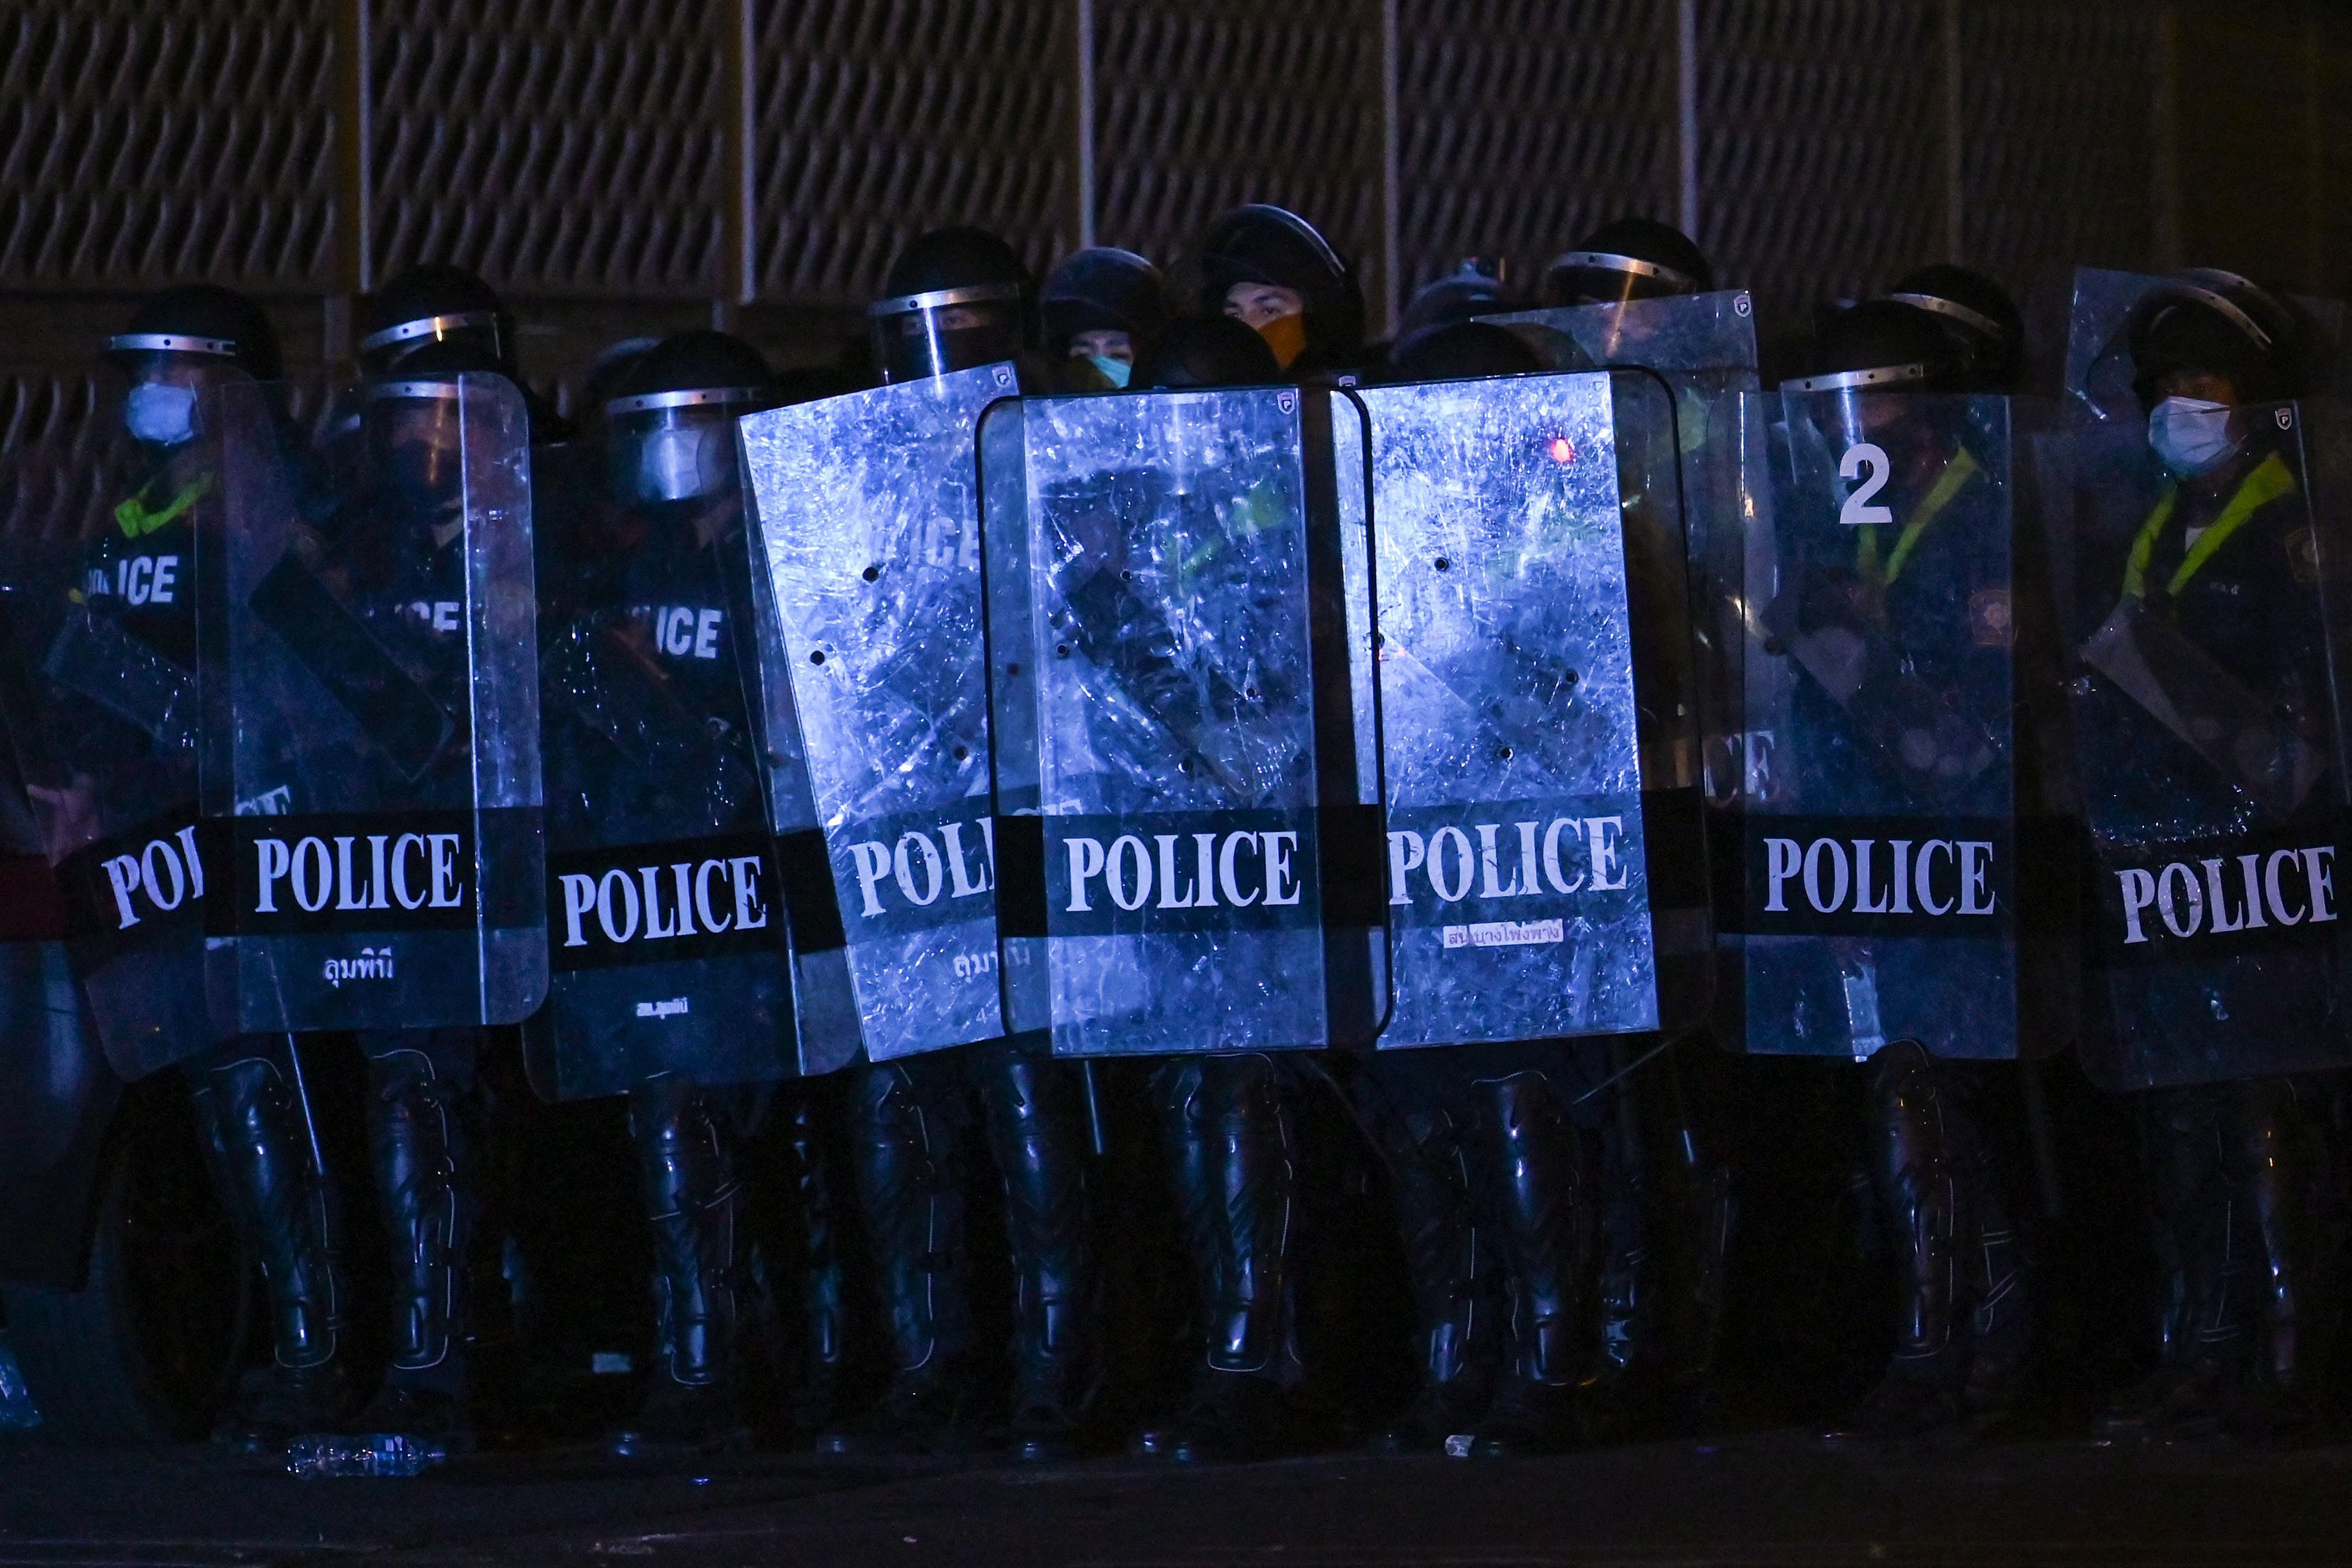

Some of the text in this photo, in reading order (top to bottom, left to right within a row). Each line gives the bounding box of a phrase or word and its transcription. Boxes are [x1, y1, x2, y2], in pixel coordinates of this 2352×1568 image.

[1838, 442, 1893, 525] 2
[101, 826, 204, 929] POL
[253, 833, 462, 912] POLICE
[558, 856, 766, 947] POLICE
[1062, 830, 1301, 912] POLICE
[1387, 816, 1627, 905] POLICE
[1763, 838, 1996, 916] POLICE
[2114, 846, 2337, 944] POLICE
